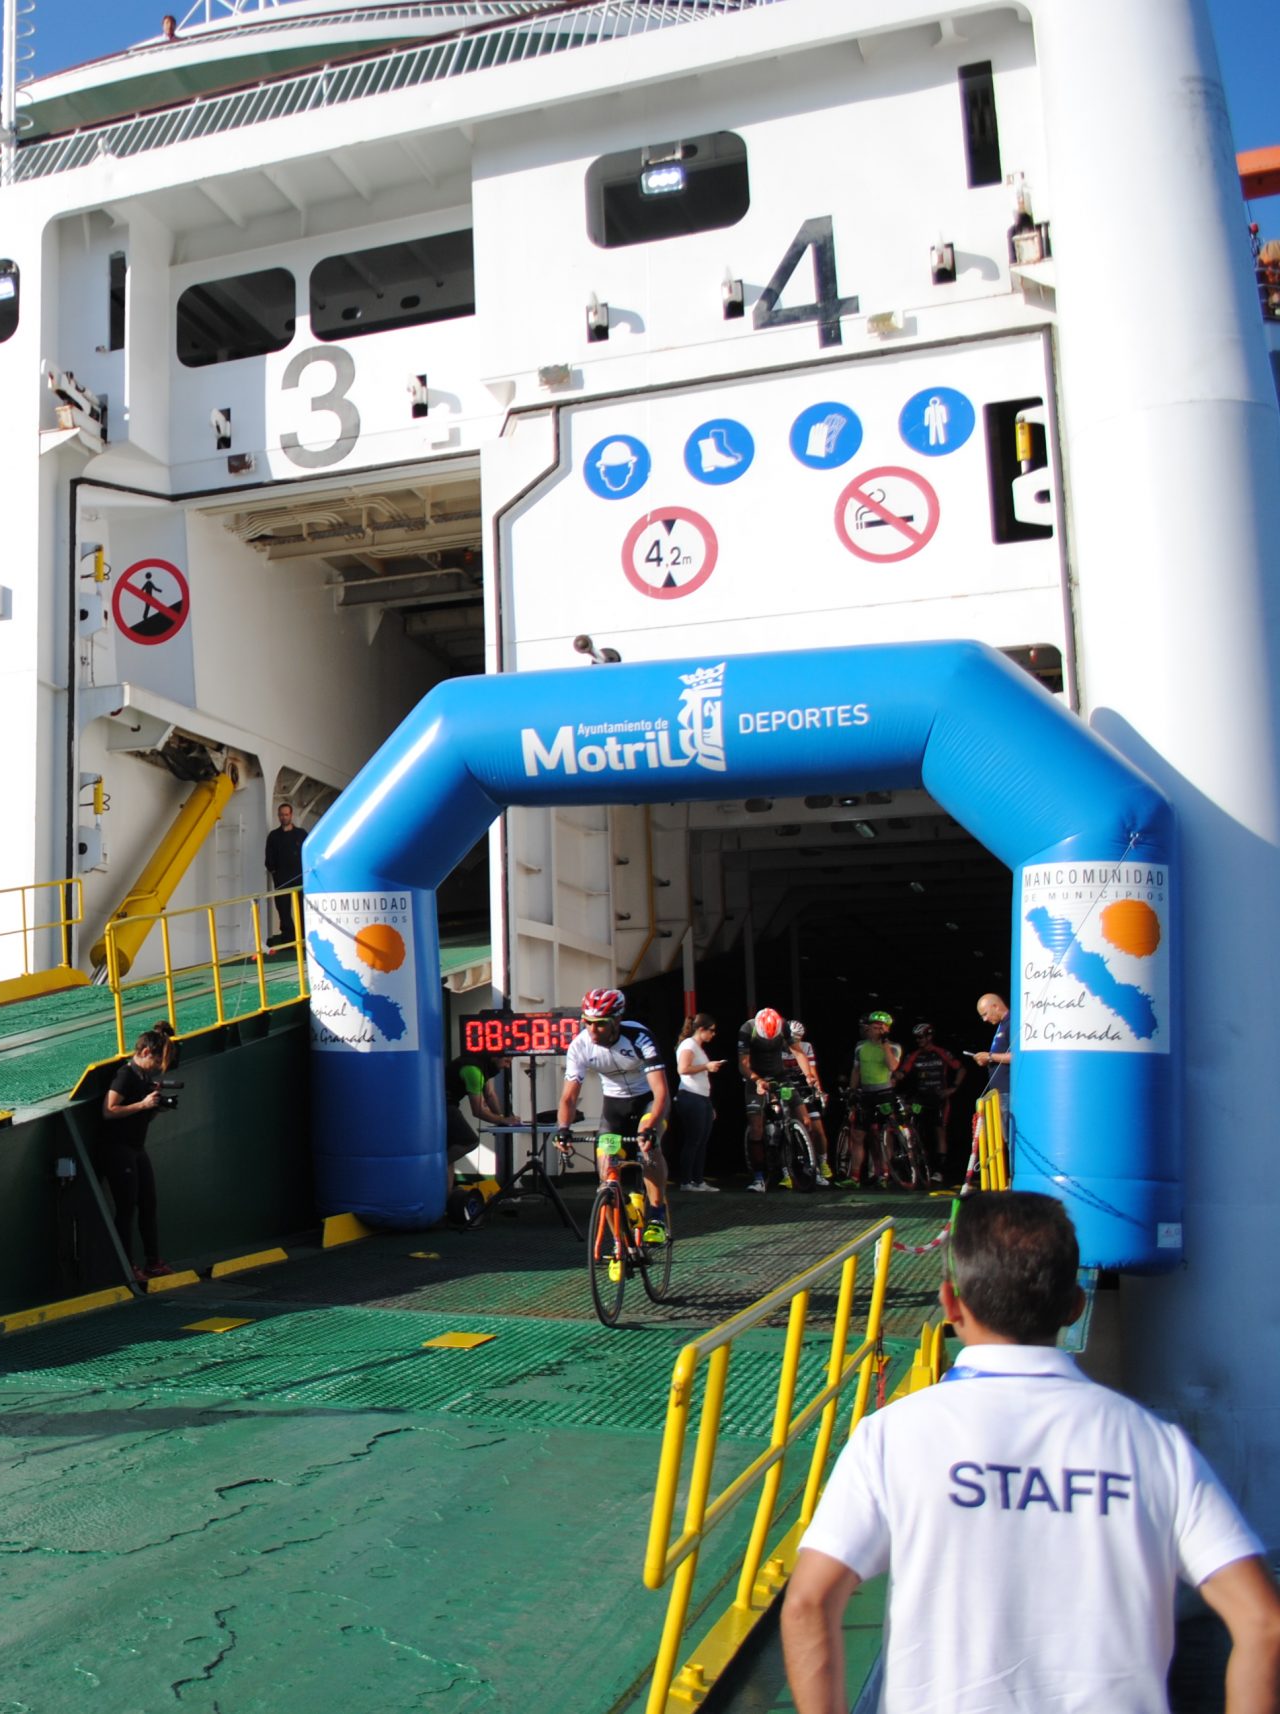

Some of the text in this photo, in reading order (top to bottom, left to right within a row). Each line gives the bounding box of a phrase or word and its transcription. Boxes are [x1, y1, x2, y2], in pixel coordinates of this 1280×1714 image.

[752, 215, 859, 349] 4
[280, 345, 361, 469] 3
[577, 717, 669, 737] Ayuntamiento de
[738, 703, 870, 735] DEPORTES
[1024, 868, 1164, 887] MANCOMUNIDAD
[1048, 890, 1164, 902] MUNICIPIOS
[1024, 962, 1063, 980] Costa
[311, 976, 331, 991] osta
[1024, 991, 1086, 1014] Tropical
[321, 1028, 376, 1044] Granada
[1024, 1022, 1122, 1041] De Granada
[948, 1461, 1132, 1516] STAFF
